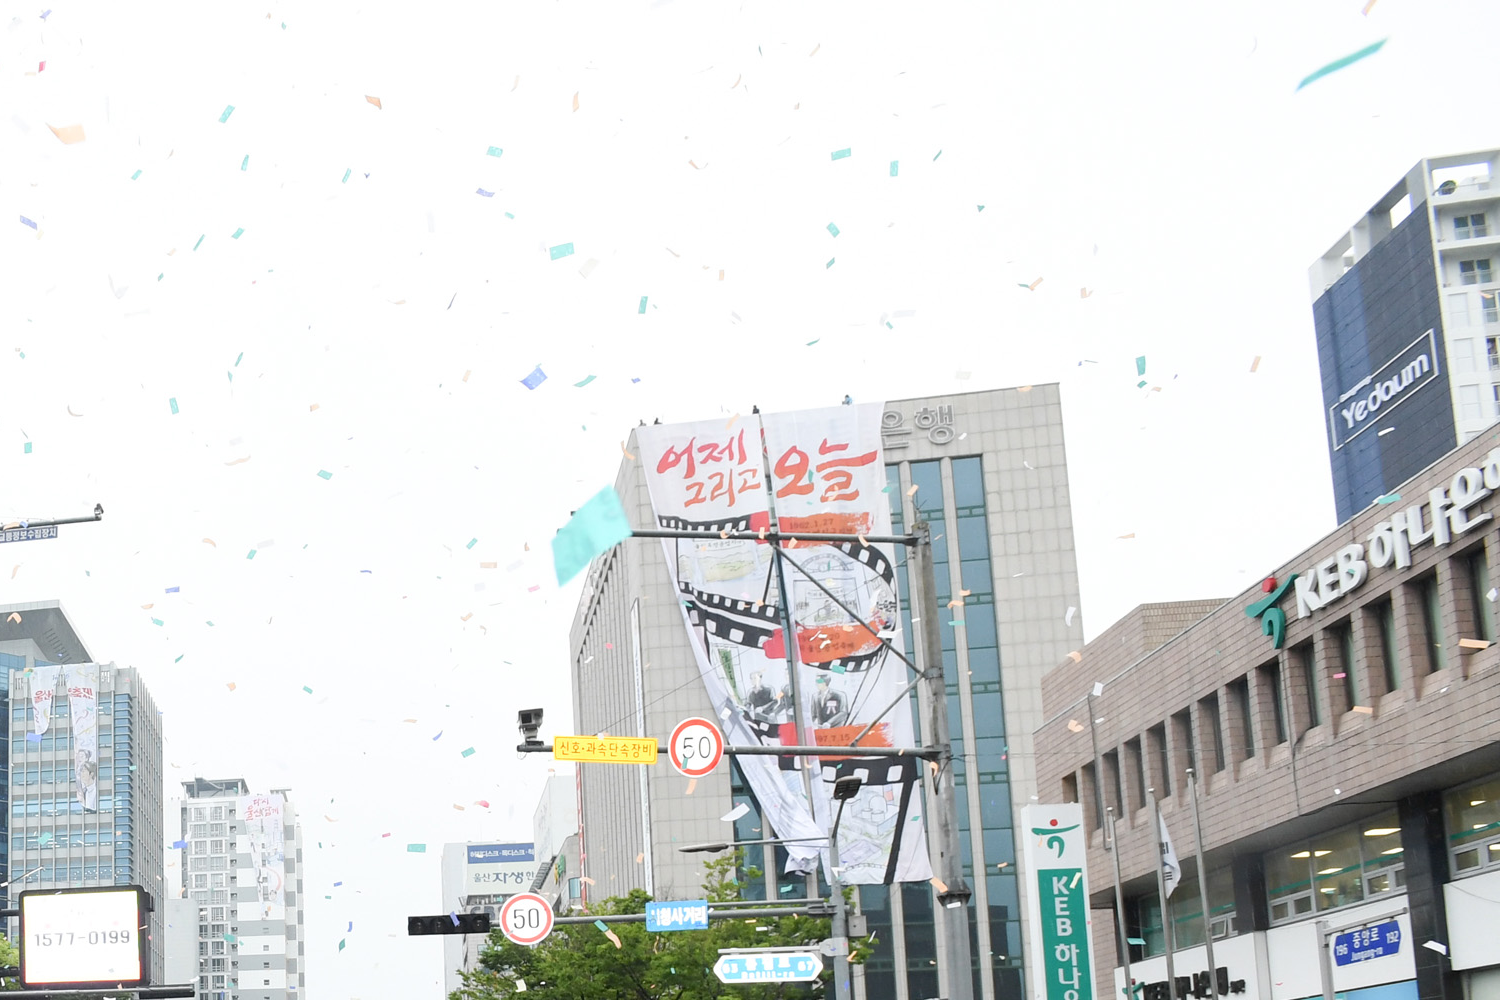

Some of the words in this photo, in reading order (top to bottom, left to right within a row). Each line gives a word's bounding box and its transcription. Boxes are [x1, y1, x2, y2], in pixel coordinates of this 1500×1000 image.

[1341, 354, 1430, 429] Yedaum
[656, 428, 748, 480] 어제
[773, 438, 879, 503] 오늘
[684, 469, 762, 508] 그리고
[1294, 543, 1368, 619] KEB
[560, 741, 653, 759] 신호·과속단속장비
[683, 736, 712, 760] 50
[474, 872, 491, 883] 울산
[492, 871, 525, 884] 자생
[513, 908, 540, 929] 50
[1052, 876, 1073, 937] KEB
[34, 929, 131, 947] 1577-0199
[1336, 943, 1349, 957] 196
[1352, 927, 1380, 949] 중앙로
[1386, 930, 1400, 944] 192
[1351, 946, 1384, 962] Jungang-ro
